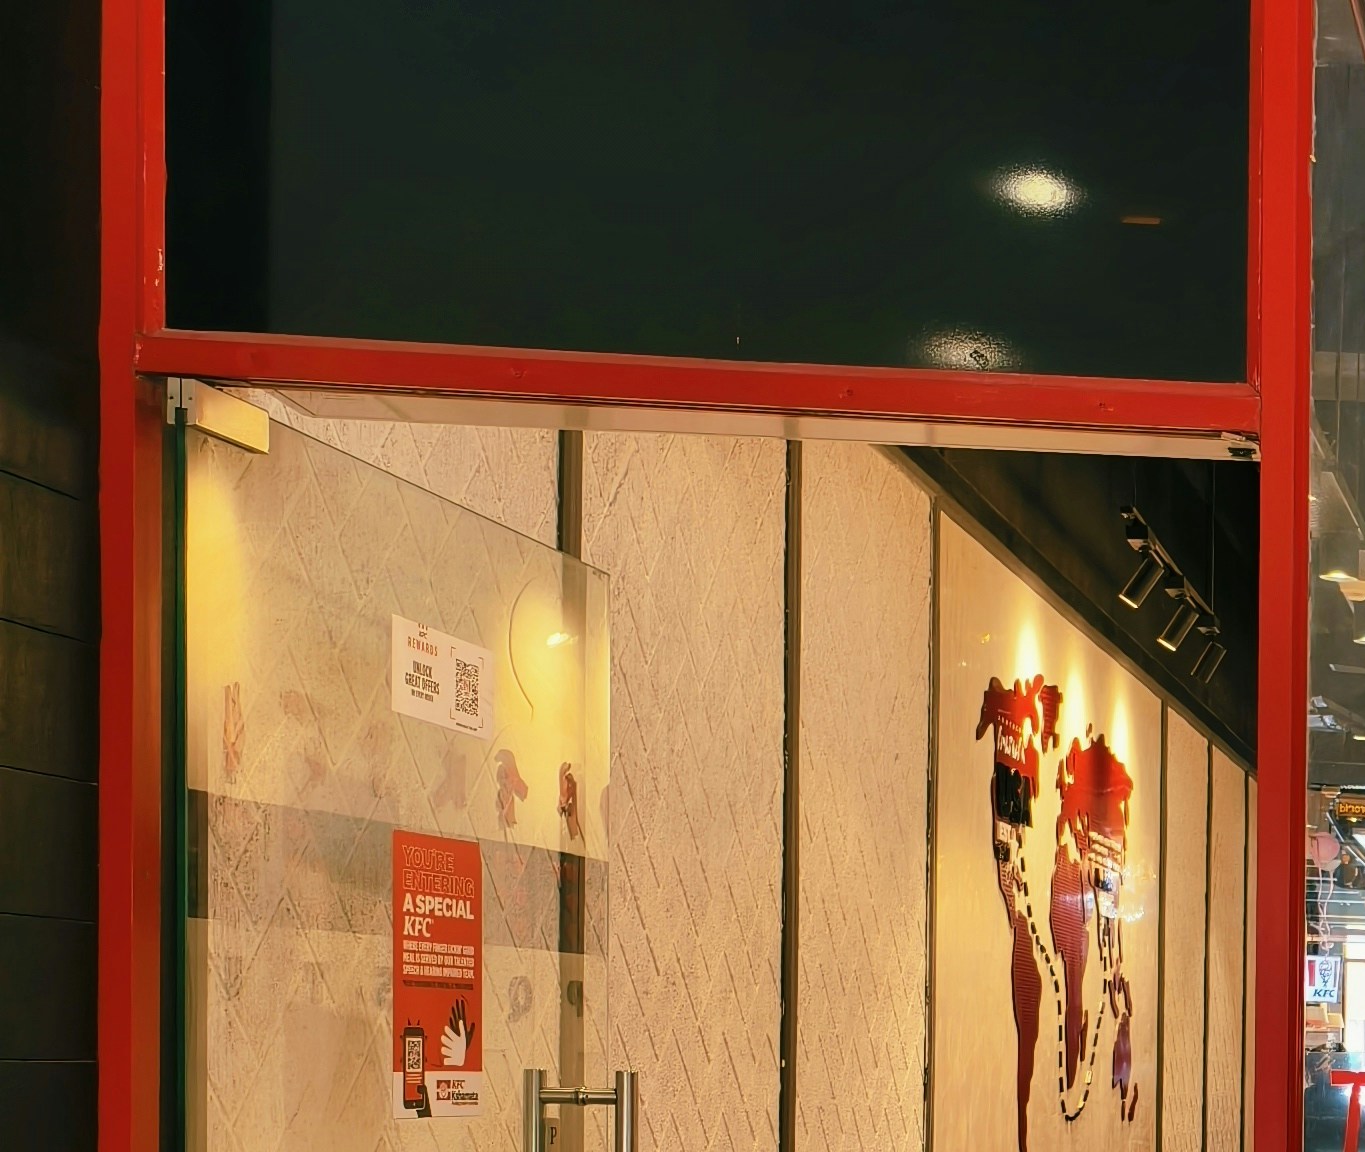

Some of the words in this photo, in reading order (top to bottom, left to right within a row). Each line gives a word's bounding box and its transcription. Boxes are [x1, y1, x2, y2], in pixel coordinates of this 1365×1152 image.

[408, 637, 437, 656] REWARDS
[413, 660, 432, 679] UNLOCK
[405, 672, 420, 688] GREAT
[422, 678, 439, 695] OFFERS
[402, 845, 455, 873] YOU'RE
[402, 869, 475, 898] ENTERING
[403, 892, 414, 913] A
[415, 895, 475, 920] SPECIAL
[403, 915, 432, 938] KFC
[1313, 988, 1335, 997] KFC
